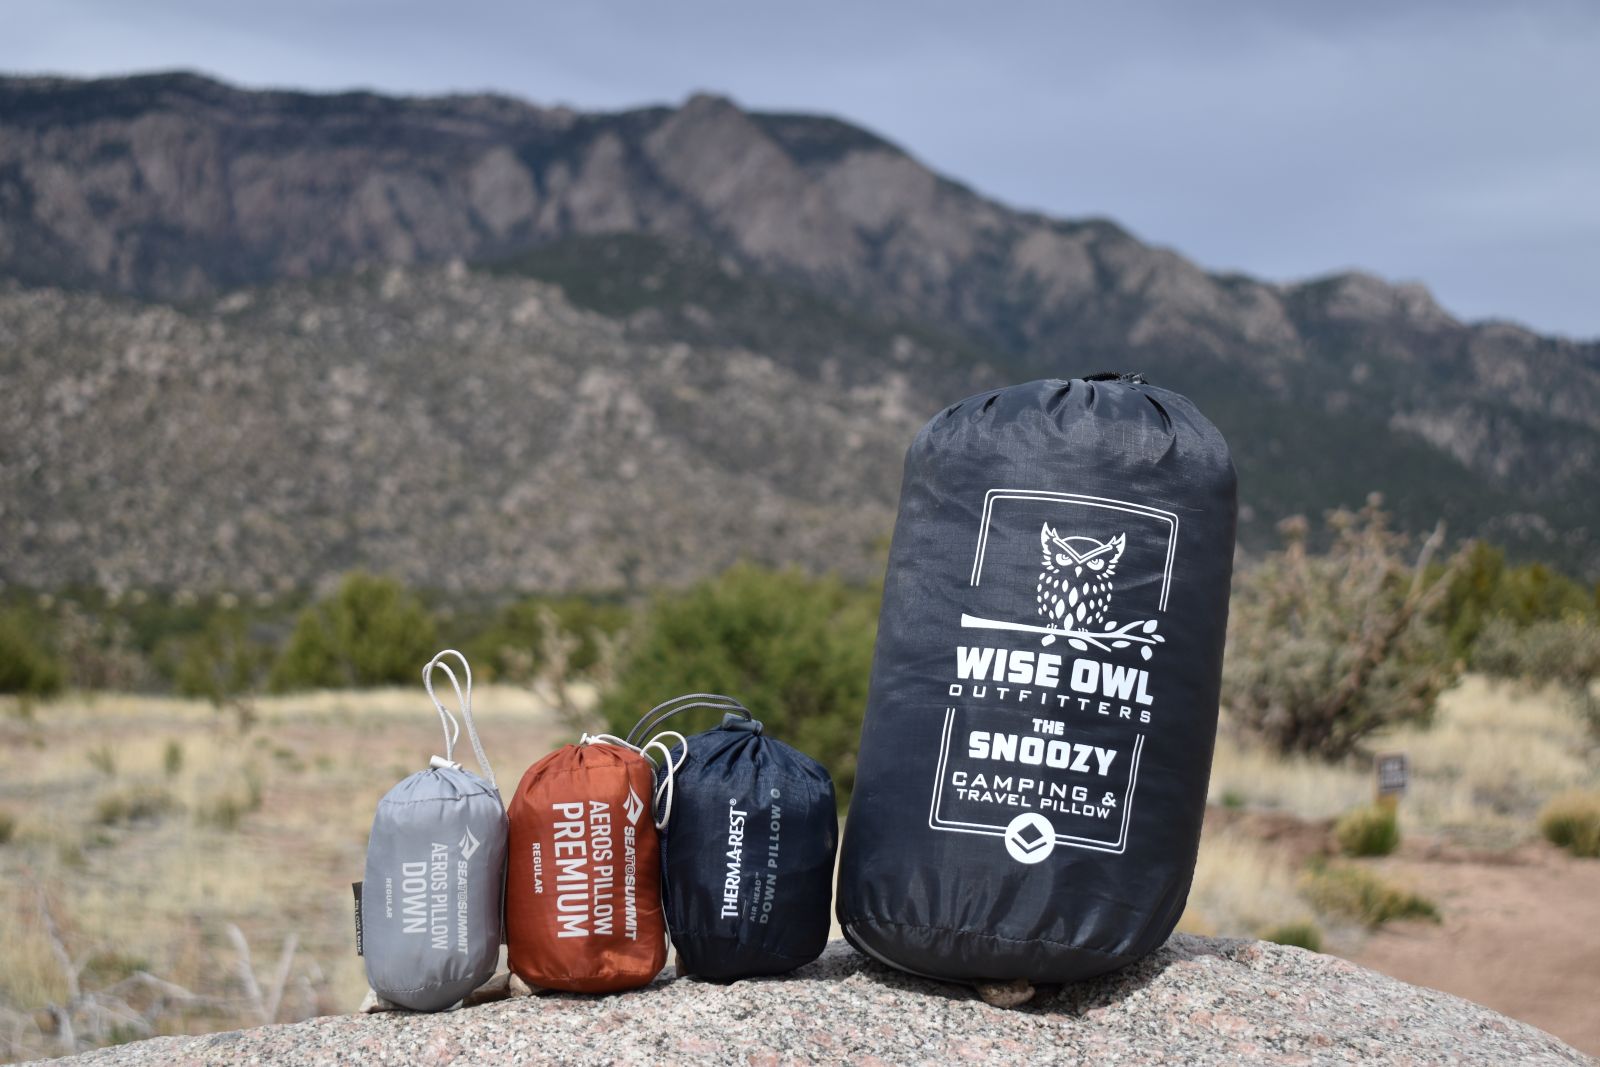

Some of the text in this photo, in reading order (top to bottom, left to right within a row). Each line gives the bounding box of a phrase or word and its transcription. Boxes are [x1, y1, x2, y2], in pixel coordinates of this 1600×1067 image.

[956, 646, 1154, 705] WISE OWL
[949, 683, 1151, 724] OUTFITTERS
[1032, 718, 1065, 735] THE
[968, 730, 1117, 776] SNOOZY
[952, 771, 1117, 807] CAMPING &
[956, 788, 1110, 819] TRAVEL PILLOW
[768, 804, 781, 868] PILLOW
[532, 842, 543, 894] REGULAR
[552, 802, 589, 938] PREMIUM
[589, 800, 613, 935] AEROS PILLOW
[402, 862, 427, 933] DOWN
[431, 843, 448, 950] AEROS PILLOW
[750, 906, 758, 922] AIR
[760, 873, 777, 924] DOWN
